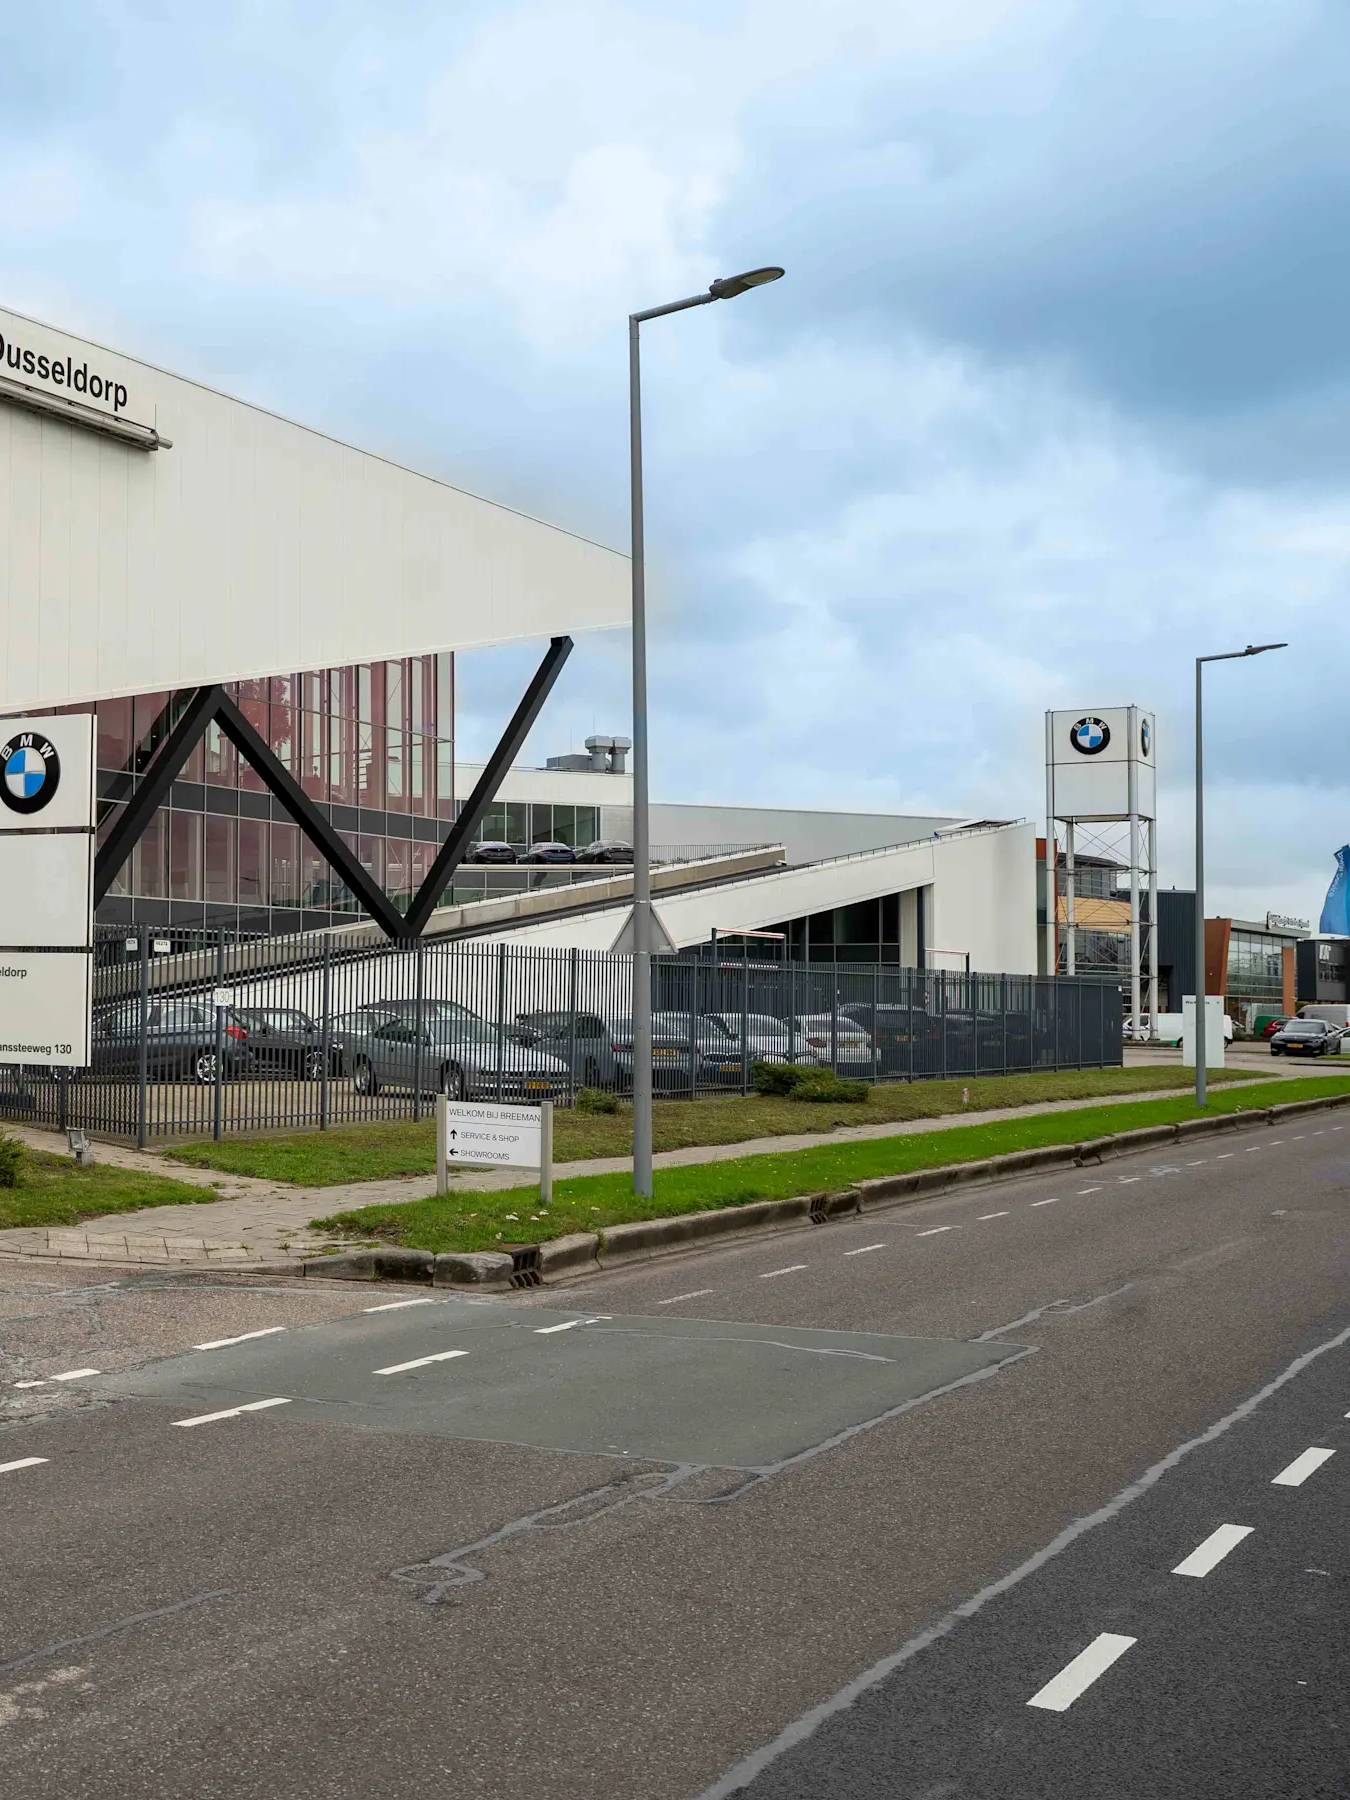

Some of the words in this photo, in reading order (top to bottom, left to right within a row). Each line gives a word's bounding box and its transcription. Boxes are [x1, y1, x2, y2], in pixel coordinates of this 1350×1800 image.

[1073, 717, 1108, 731] BMW
[1, 734, 55, 761] BMW
[215, 991, 230, 1003] 130
[54, 1044, 72, 1055] 130
[449, 1108, 485, 1118] WELKOM
[486, 1111, 499, 1119] BIJ
[500, 1112, 541, 1122] BREEMAN
[460, 1131, 491, 1141] SERVICE
[498, 1134, 520, 1143] SHOP
[460, 1149, 510, 1161] SHOWROOMS
